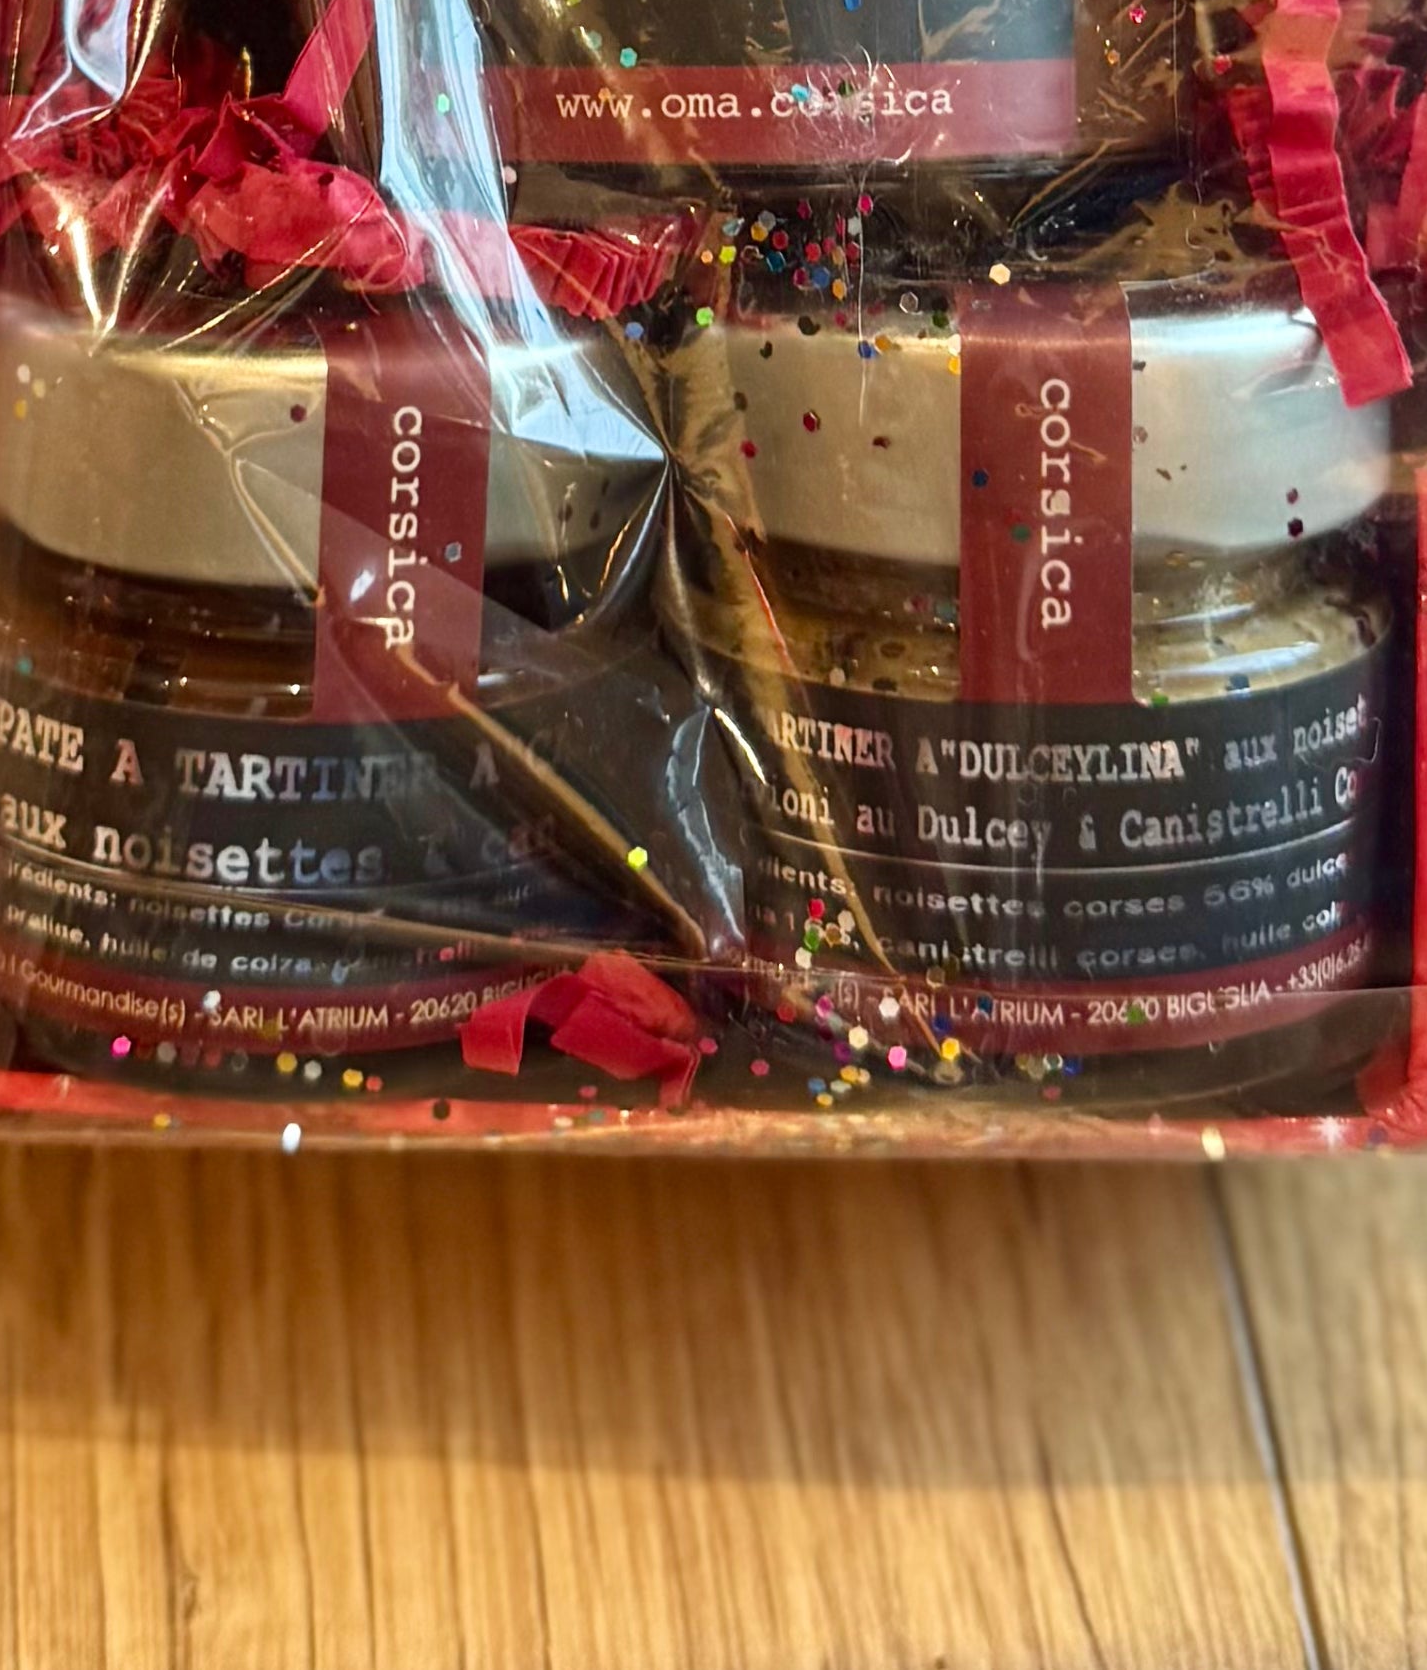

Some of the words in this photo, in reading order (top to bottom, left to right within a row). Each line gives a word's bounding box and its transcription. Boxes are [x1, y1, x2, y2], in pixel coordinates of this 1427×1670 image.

[385, 404, 429, 652] corsica
[1039, 378, 1085, 631] corsica
[110, 737, 145, 787] A
[1224, 732, 1278, 772] aux
[0, 792, 68, 851] aux
[93, 824, 385, 886] noisettes
[918, 804, 1053, 855] Dulcey
[1120, 776, 1323, 850] Canistrelli
[410, 990, 478, 1024] 20620
